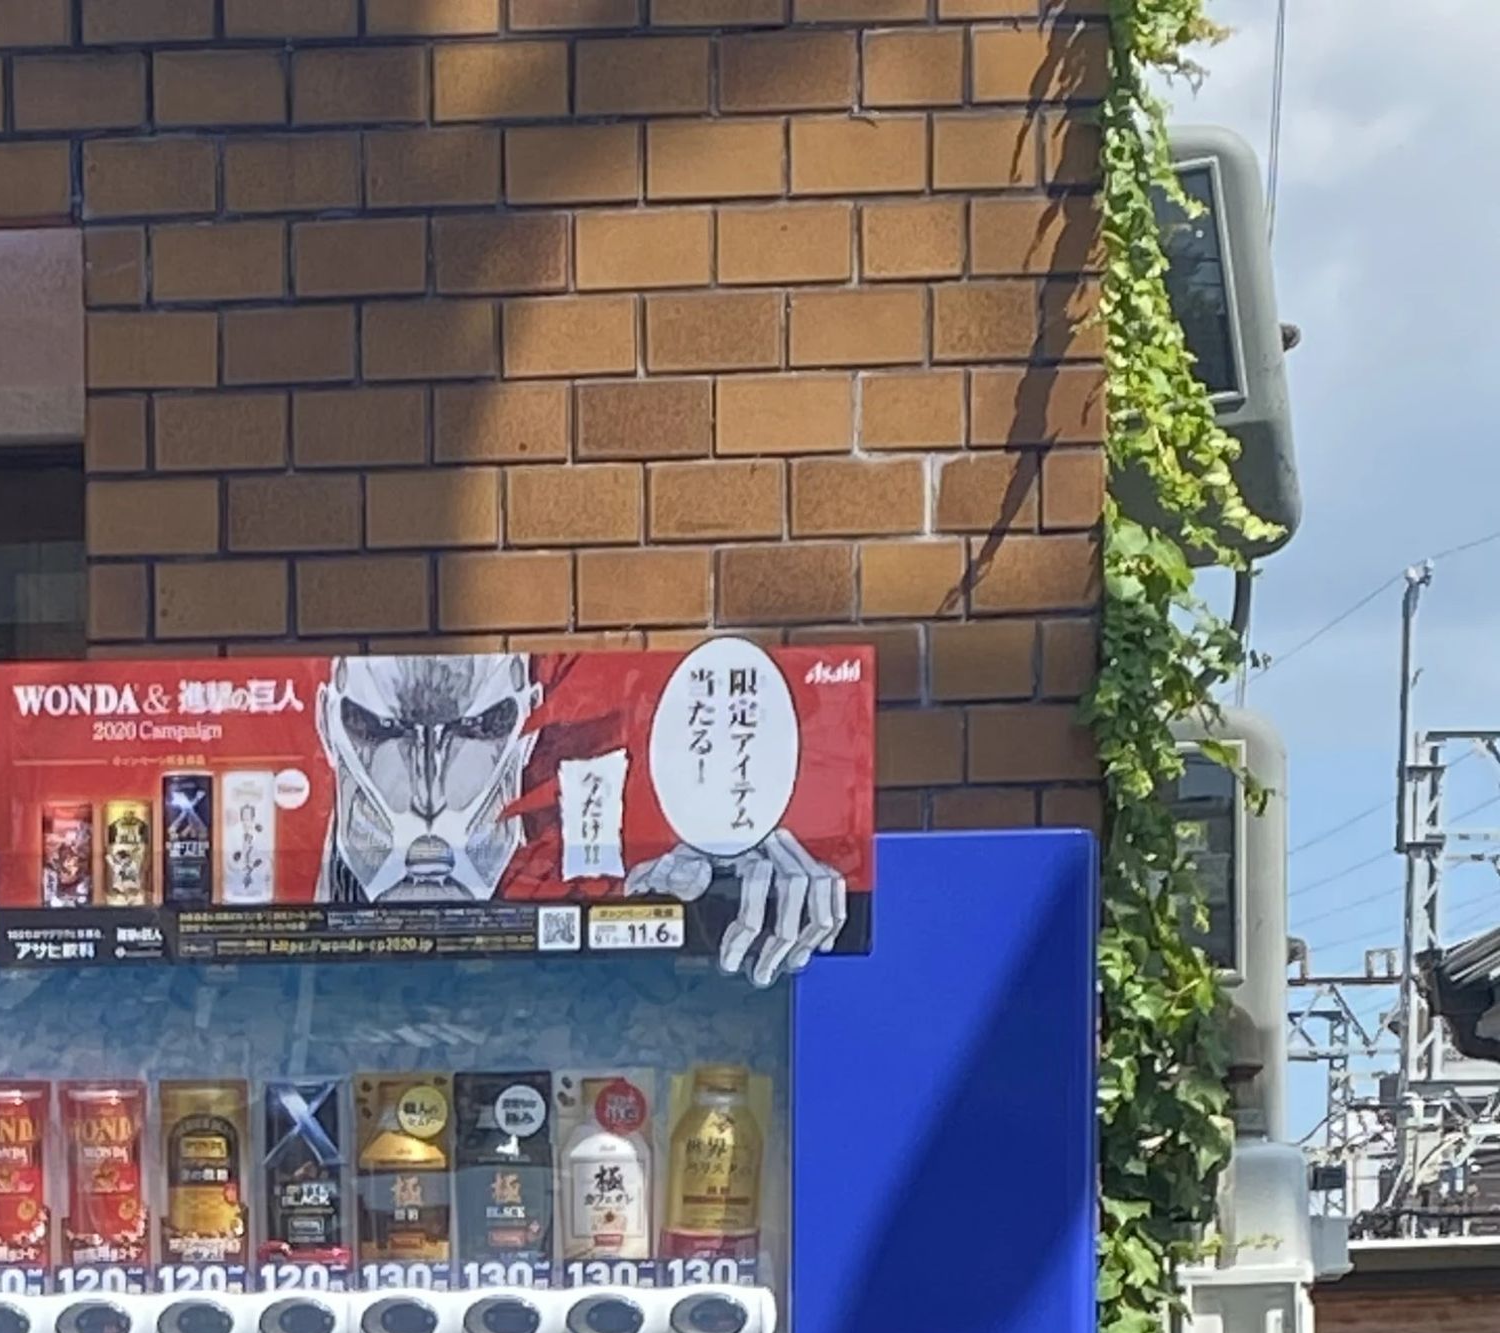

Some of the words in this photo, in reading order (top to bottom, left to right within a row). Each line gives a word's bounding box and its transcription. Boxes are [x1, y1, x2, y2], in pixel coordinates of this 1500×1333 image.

[13, 683, 141, 717] WONDA
[143, 683, 171, 715] &
[178, 679, 304, 715] 進撃の巨人
[92, 720, 137, 741] 2020
[139, 720, 223, 744] Campaign
[728, 667, 758, 831] 限定アイテム
